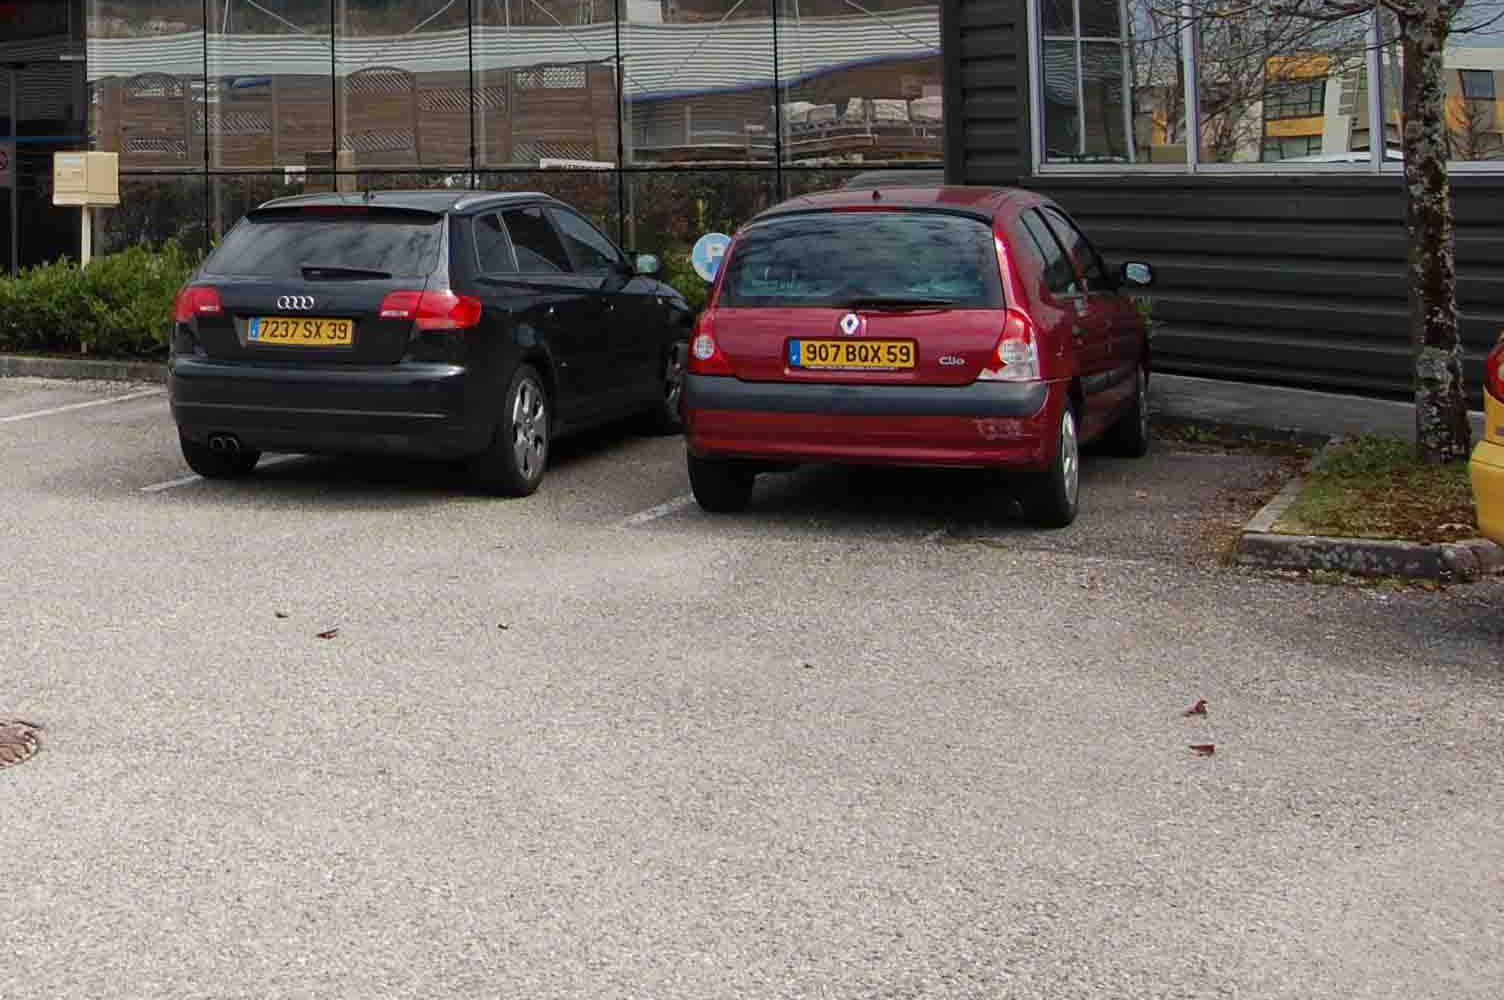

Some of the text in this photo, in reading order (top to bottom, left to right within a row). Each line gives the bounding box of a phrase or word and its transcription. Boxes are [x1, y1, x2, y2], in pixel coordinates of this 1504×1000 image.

[260, 319, 348, 340] 7237 SX 39
[805, 343, 911, 363] 907 BQX 59
